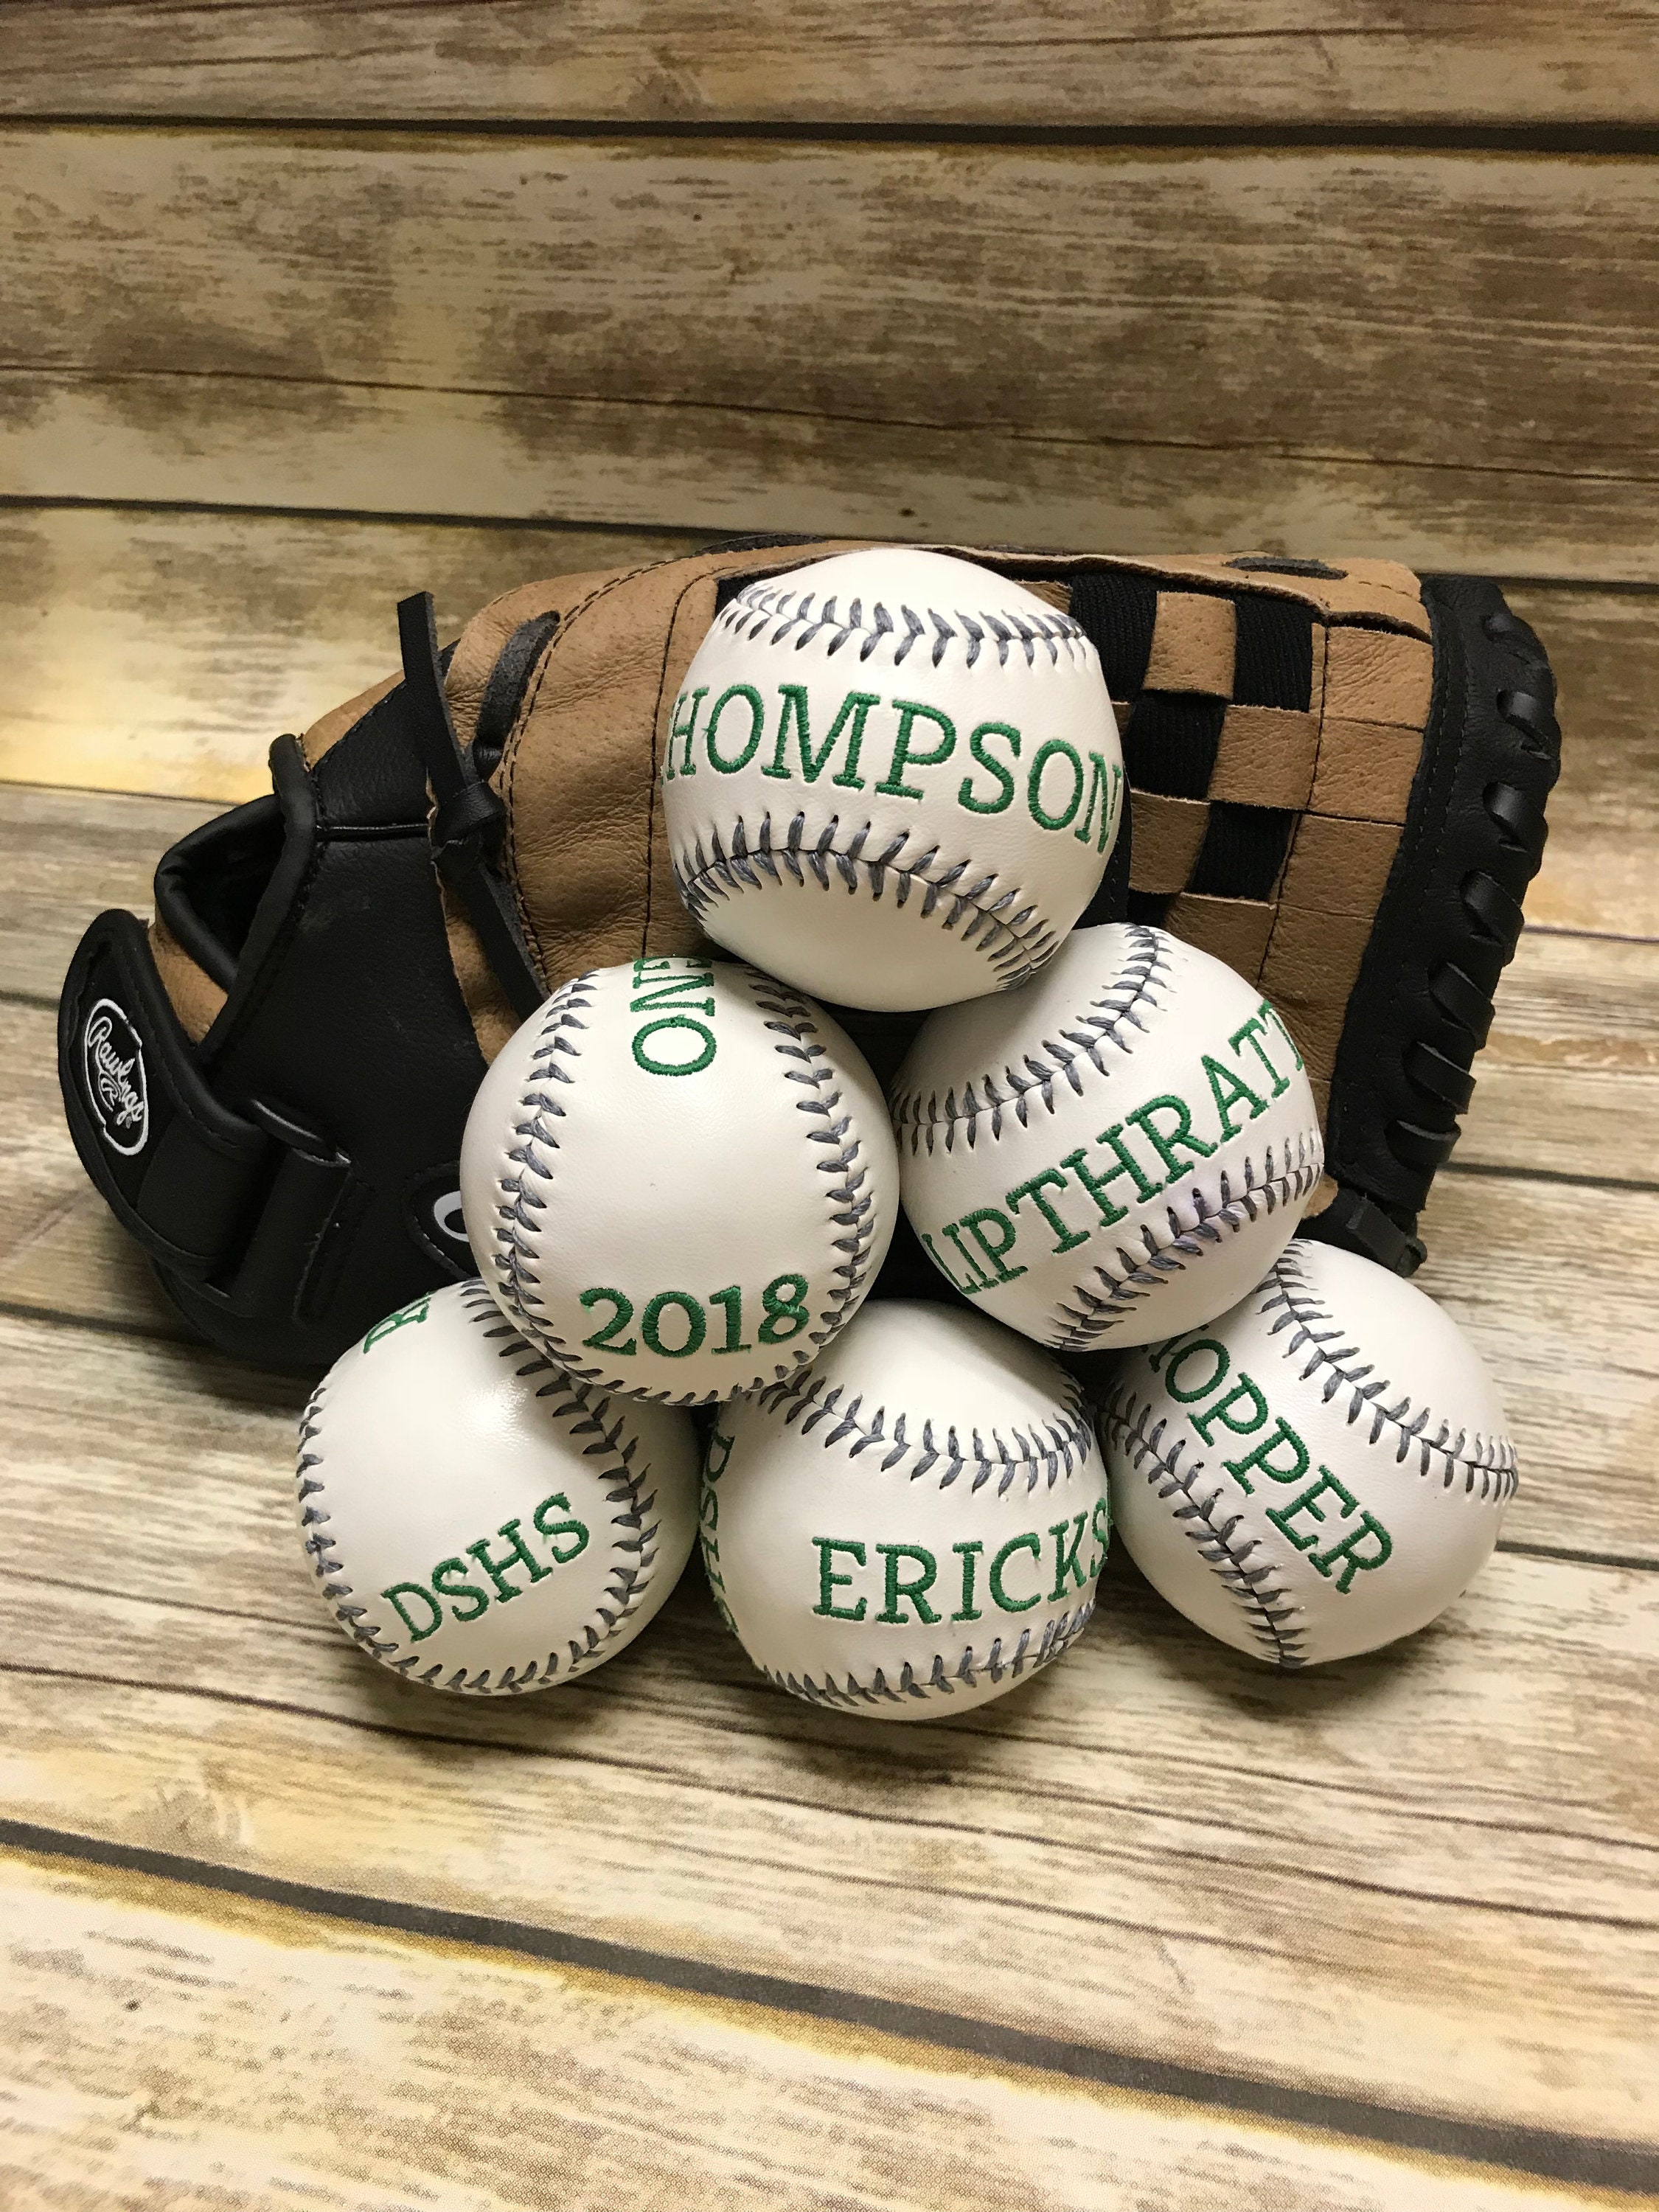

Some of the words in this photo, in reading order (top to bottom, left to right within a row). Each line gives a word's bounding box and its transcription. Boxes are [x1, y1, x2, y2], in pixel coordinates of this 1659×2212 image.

[661, 684, 1121, 853] HOMPSON
[88, 1016, 145, 1127] Rawlings
[580, 1274, 810, 1357] 2018
[381, 1492, 590, 1643] DSHS
[812, 1480, 1113, 1624] ERICKS
